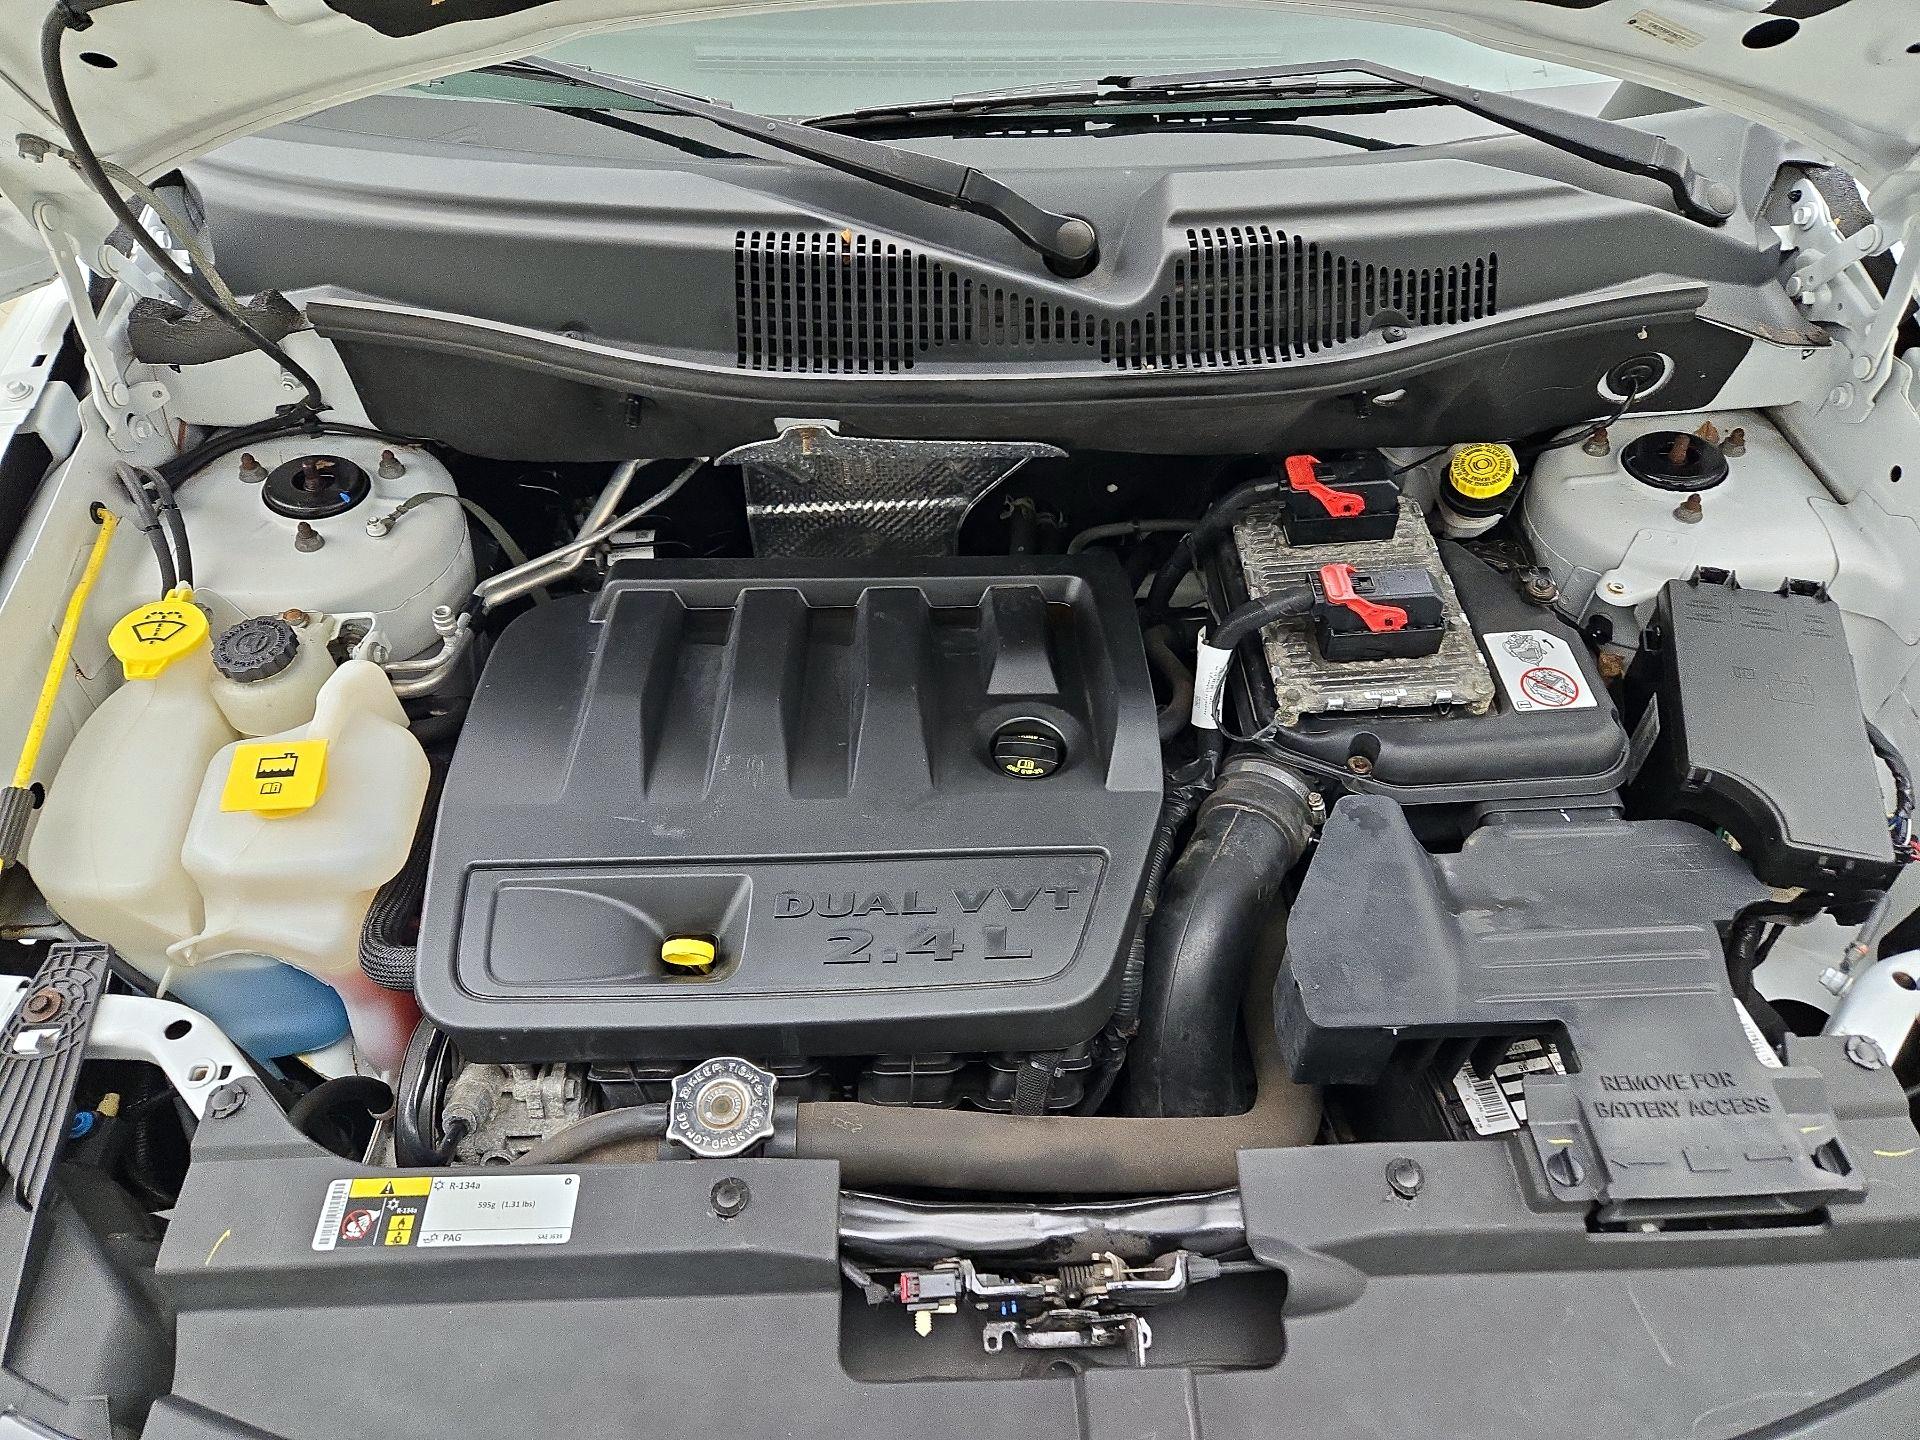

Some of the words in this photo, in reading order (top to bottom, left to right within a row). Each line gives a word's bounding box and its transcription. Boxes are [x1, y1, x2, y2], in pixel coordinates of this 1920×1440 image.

[773, 889, 938, 918] DUAL
[951, 887, 1079, 914] VVT
[823, 926, 1033, 965] 2.4L
[690, 1063, 722, 1087] KEEP
[728, 1062, 760, 1084] TIGHT
[1600, 1073, 1688, 1091] REMOVE
[1690, 1071, 1737, 1089] FOR
[1594, 1100, 1681, 1118] BATTERY
[1688, 1096, 1772, 1117] ACCESS
[676, 1112, 690, 1129] DO
[685, 1129, 711, 1146] NOT
[711, 1131, 745, 1149] OPEN
[744, 1112, 764, 1135] HOT
[449, 1181, 481, 1190] R-134a
[477, 1201, 496, 1210] 595g
[501, 1200, 520, 1210] (1.31
[521, 1199, 536, 1209] lbs)
[443, 1233, 462, 1242] PAG
